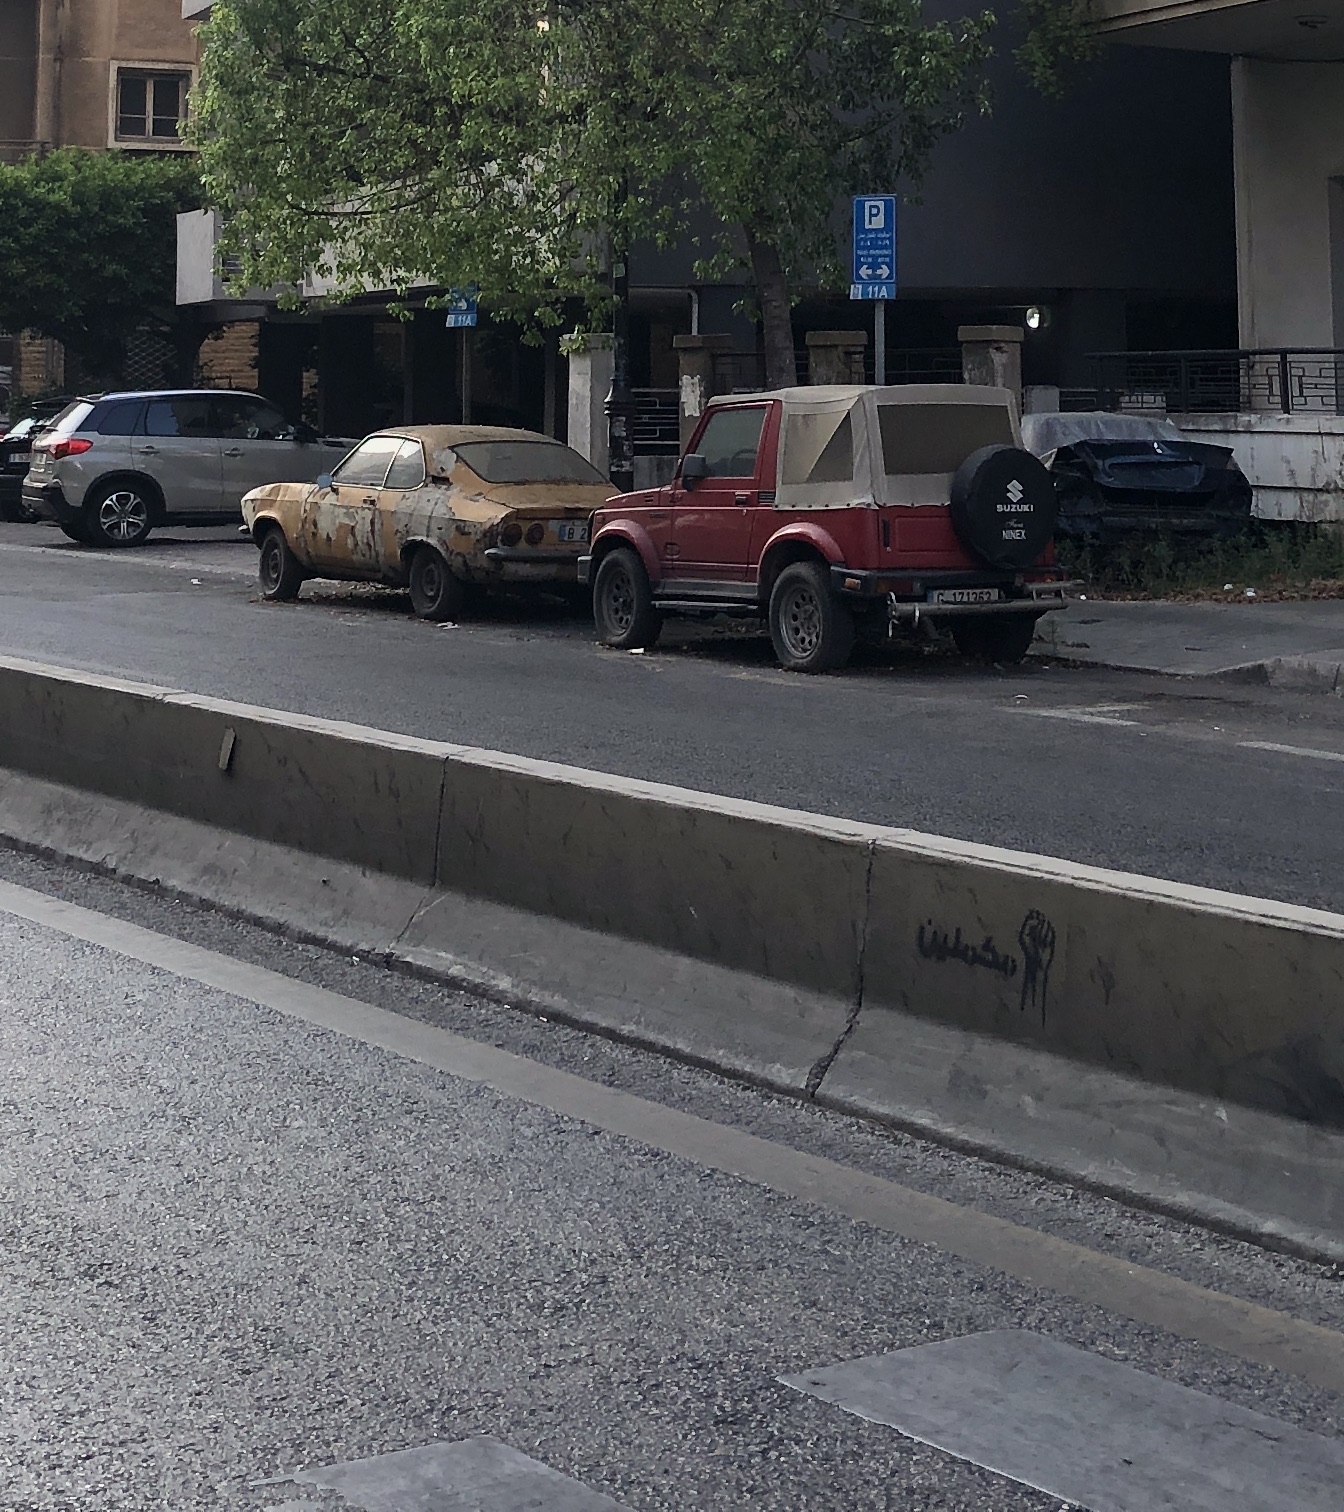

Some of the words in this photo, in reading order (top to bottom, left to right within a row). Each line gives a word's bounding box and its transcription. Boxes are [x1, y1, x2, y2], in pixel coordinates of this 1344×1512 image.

[868, 204, 881, 226] P
[867, 285, 888, 299] 11A
[458, 314, 472, 326] 11A
[996, 504, 1034, 512] SUZUKI
[567, 527, 575, 540] B
